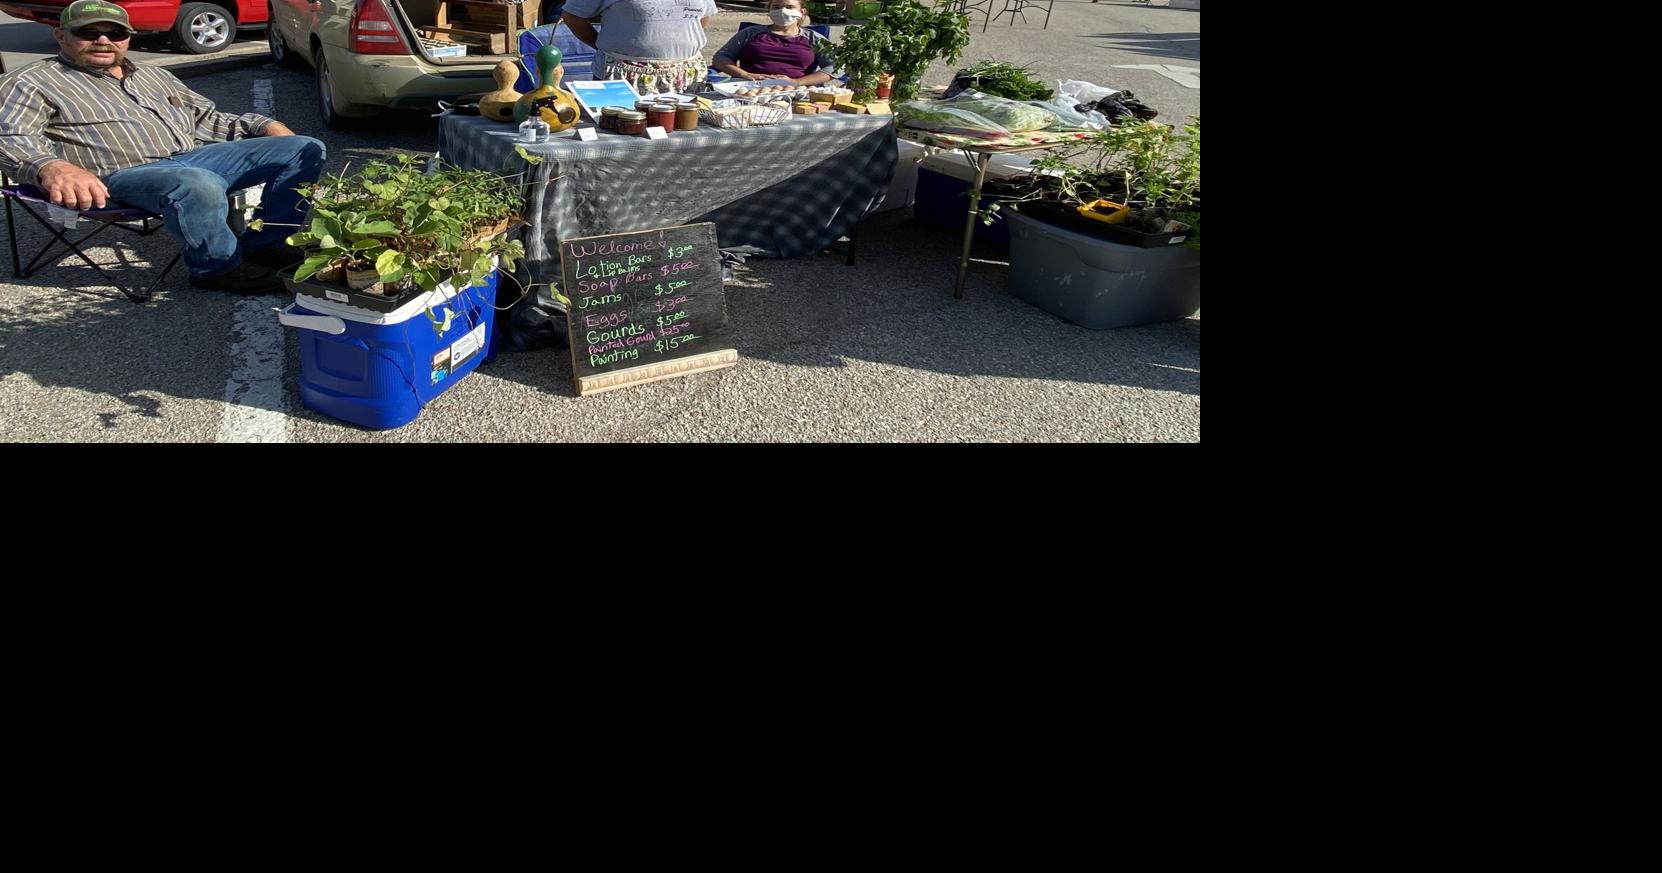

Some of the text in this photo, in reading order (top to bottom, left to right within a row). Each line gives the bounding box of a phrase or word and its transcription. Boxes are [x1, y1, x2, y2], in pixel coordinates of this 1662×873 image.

[575, 260, 622, 280] Lotion
[628, 254, 652, 266] Bars
[578, 278, 618, 293] Soap
[625, 271, 653, 285] Bars
[578, 293, 622, 309] Jams
[585, 310, 628, 329] Eggs
[586, 323, 646, 345] Gourds
[588, 339, 625, 355] Painted
[590, 348, 639, 367] Painting
